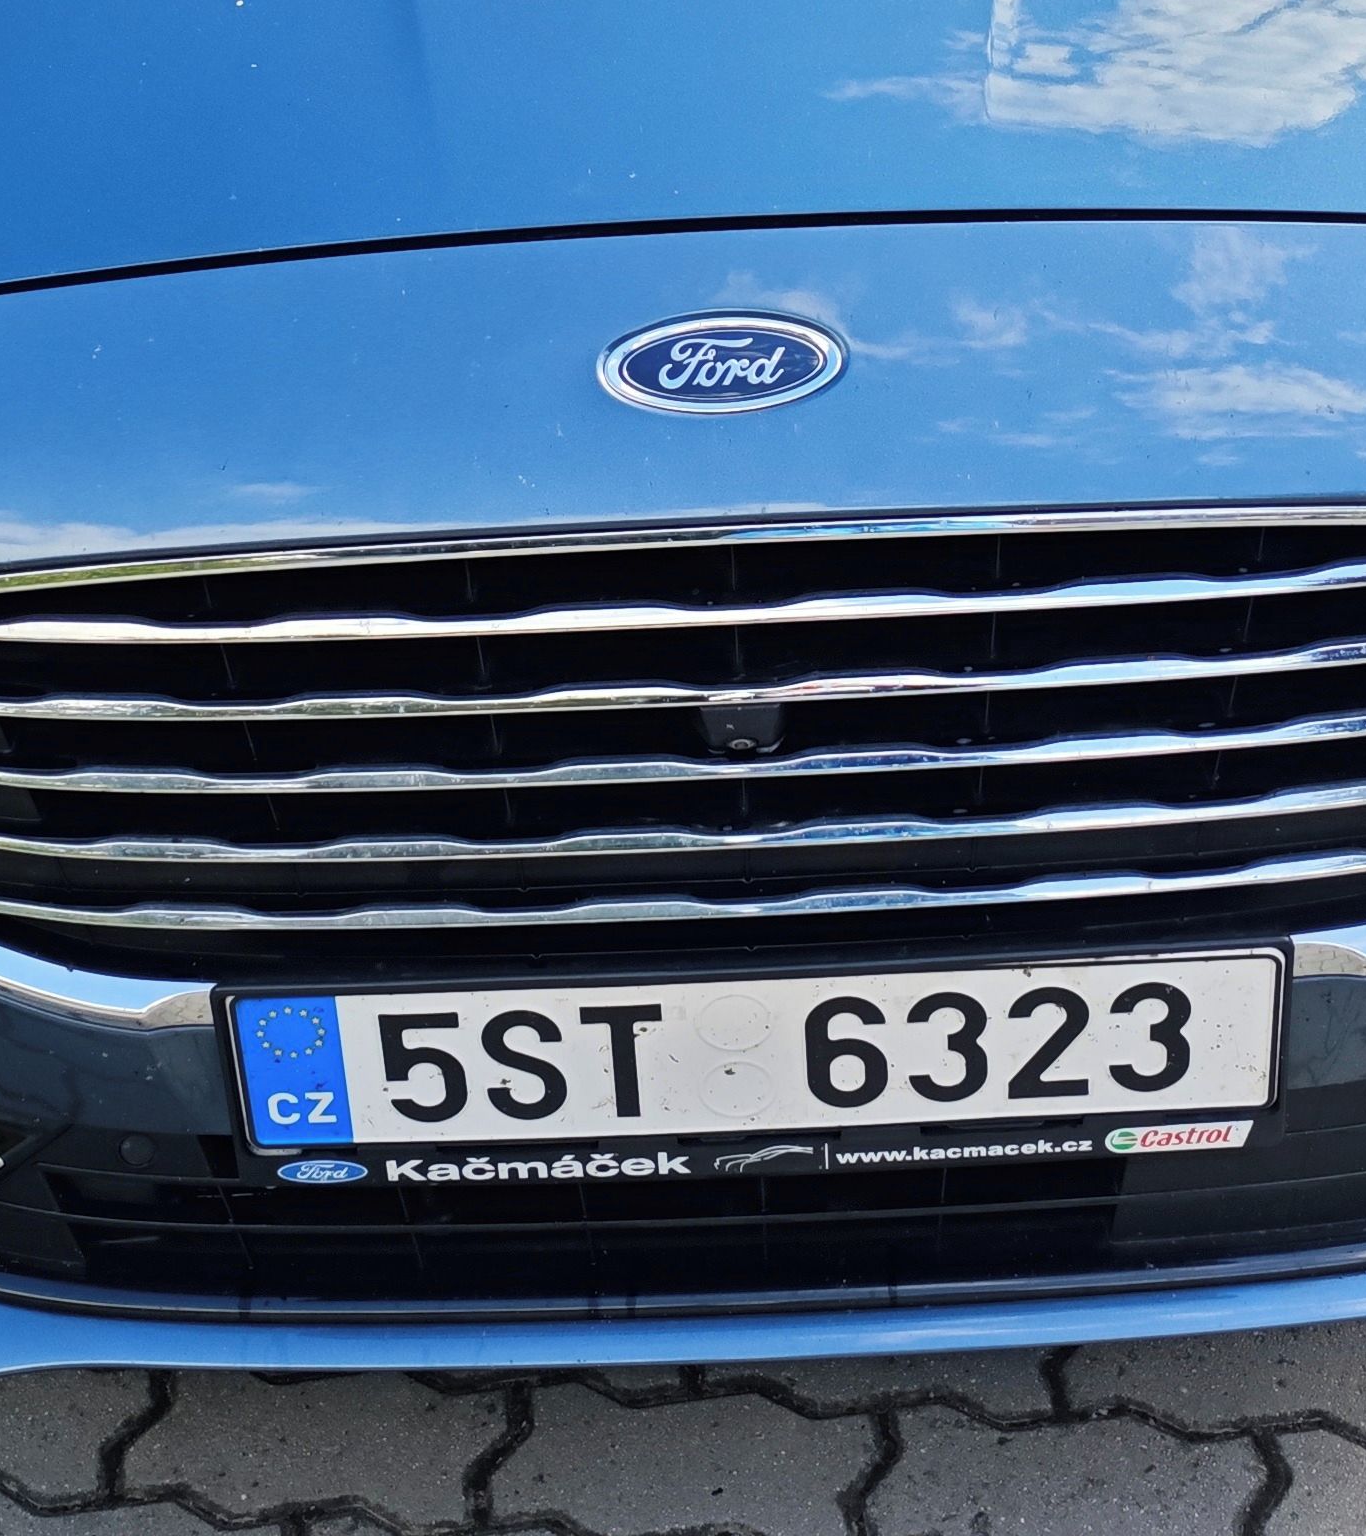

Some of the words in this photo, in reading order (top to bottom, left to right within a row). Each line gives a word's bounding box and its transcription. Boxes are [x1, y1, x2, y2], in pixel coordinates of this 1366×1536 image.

[658, 337, 785, 390] Ford
[378, 1003, 663, 1124] 5ST
[804, 981, 1192, 1108] 6323
[267, 1091, 337, 1126] CZ
[836, 1137, 1093, 1165] www.kacmacek.cz
[1140, 1125, 1233, 1148] Castrol
[296, 1163, 349, 1180] Ford
[386, 1152, 692, 1183] Kačmáček
